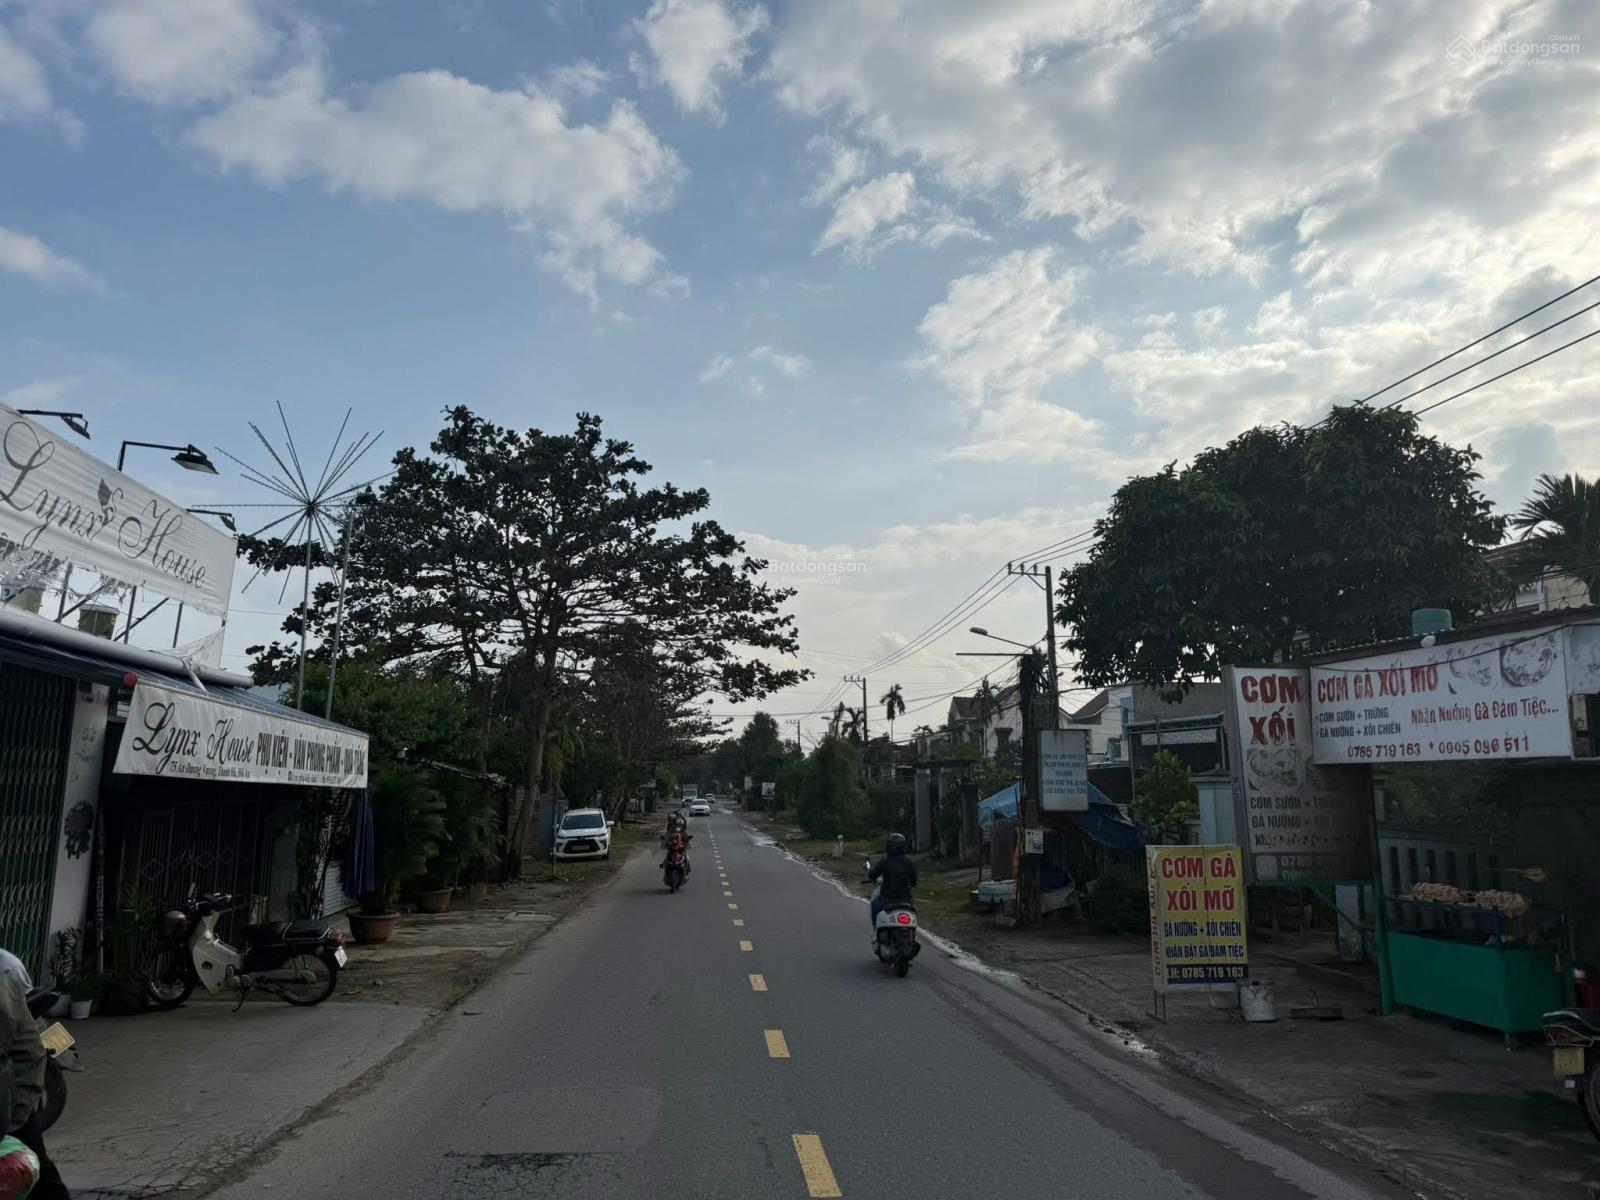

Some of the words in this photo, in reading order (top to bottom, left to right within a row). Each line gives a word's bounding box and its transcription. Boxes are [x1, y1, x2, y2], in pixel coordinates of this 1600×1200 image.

[0, 421, 110, 551] Lynx
[118, 499, 207, 588] House
[1240, 673, 1303, 704] CƠM
[1318, 673, 1349, 703] CƠM
[1354, 667, 1374, 699] GÀ
[1474, 701, 1489, 721] Gà
[132, 702, 200, 775] Lynx
[206, 718, 254, 765] House
[1348, 745, 1373, 758] 0785
[1376, 744, 1397, 757] 719
[1400, 743, 1421, 756] 163
[1438, 740, 1470, 754] 0905
[1475, 738, 1499, 754] 096
[1504, 735, 1529, 752] 511
[1250, 795, 1272, 809] CƠM
[1252, 813, 1265, 828] GÀ
[1162, 856, 1203, 878] CƠM
[1210, 853, 1236, 878] GÀ
[1166, 882, 1197, 911] XỐI
[1204, 884, 1235, 911] MỠ
[1182, 967, 1205, 978] 0785
[1206, 967, 1224, 978] 719
[1226, 967, 1244, 978] 163
